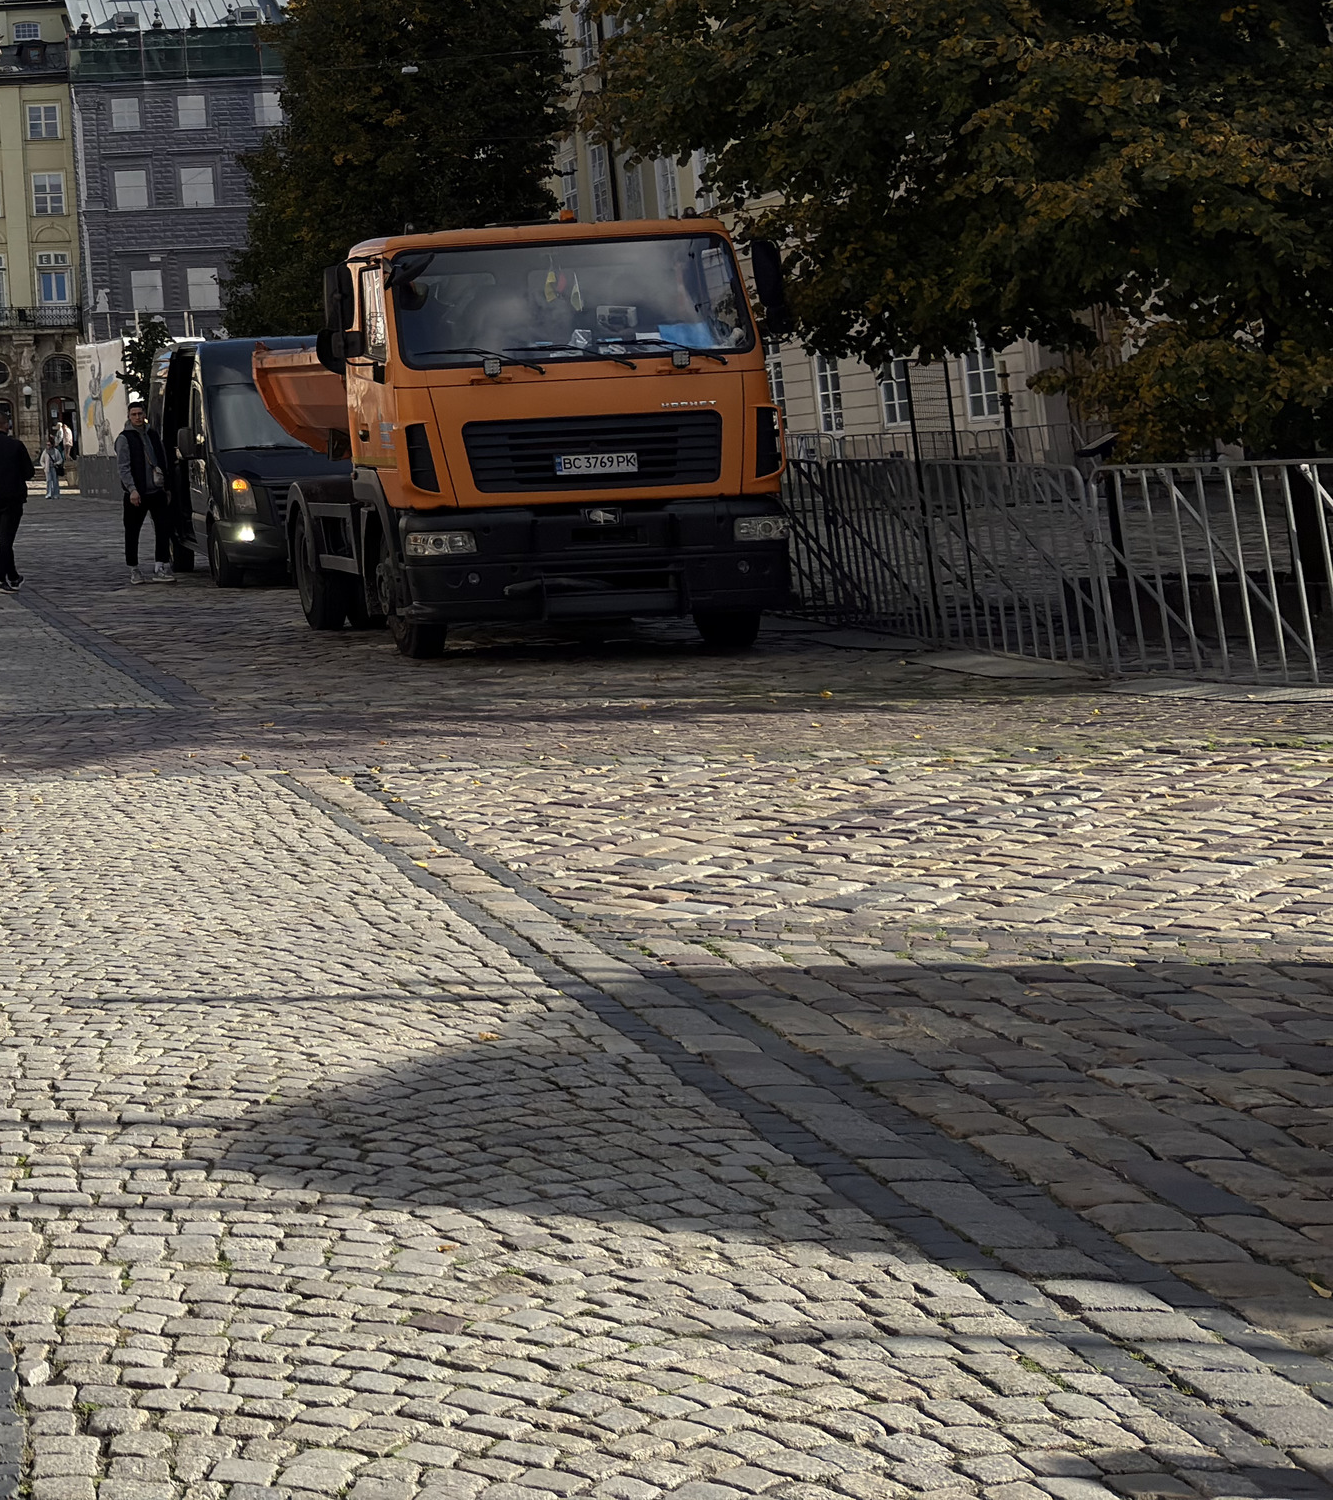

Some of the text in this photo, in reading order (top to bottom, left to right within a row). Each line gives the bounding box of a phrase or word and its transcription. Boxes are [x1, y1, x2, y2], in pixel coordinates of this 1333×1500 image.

[563, 457, 582, 470] BC
[584, 456, 614, 469] 3769
[616, 454, 636, 467] PK
